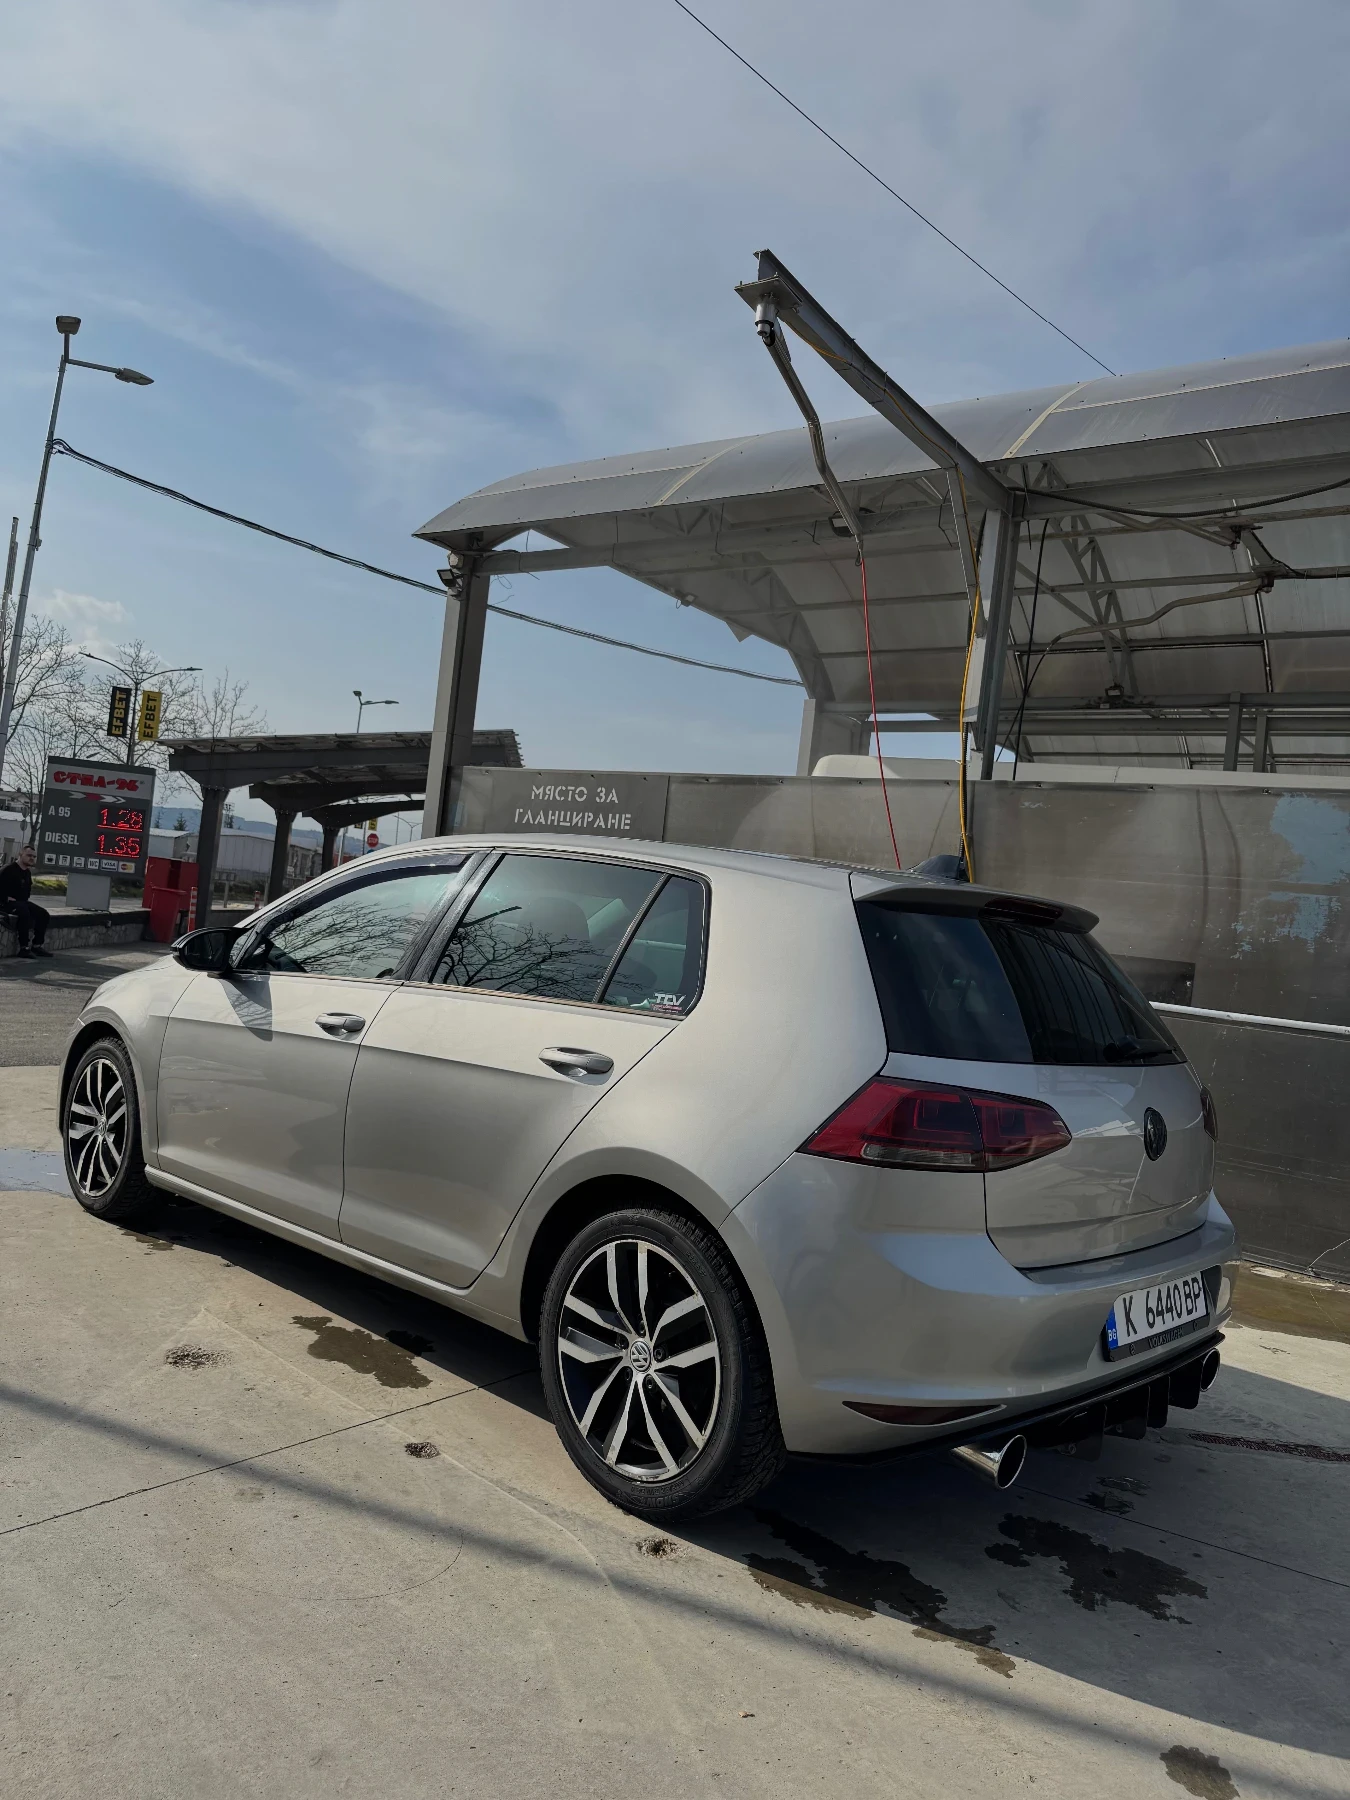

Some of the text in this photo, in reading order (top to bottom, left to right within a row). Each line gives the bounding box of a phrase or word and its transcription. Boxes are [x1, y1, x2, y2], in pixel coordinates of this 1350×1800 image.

[111, 690, 127, 735] EFBET
[142, 694, 158, 738] EFBET
[531, 785, 619, 804] МЯСТО ЗА
[58, 806, 71, 818] 95
[100, 808, 143, 829] 1.28
[514, 808, 632, 830] ГЛАНЦИРАНЕ
[45, 831, 80, 846] DIESEL
[97, 834, 140, 855] 1.35
[1122, 1294, 1138, 1338] K
[1108, 1328, 1117, 1342] BG
